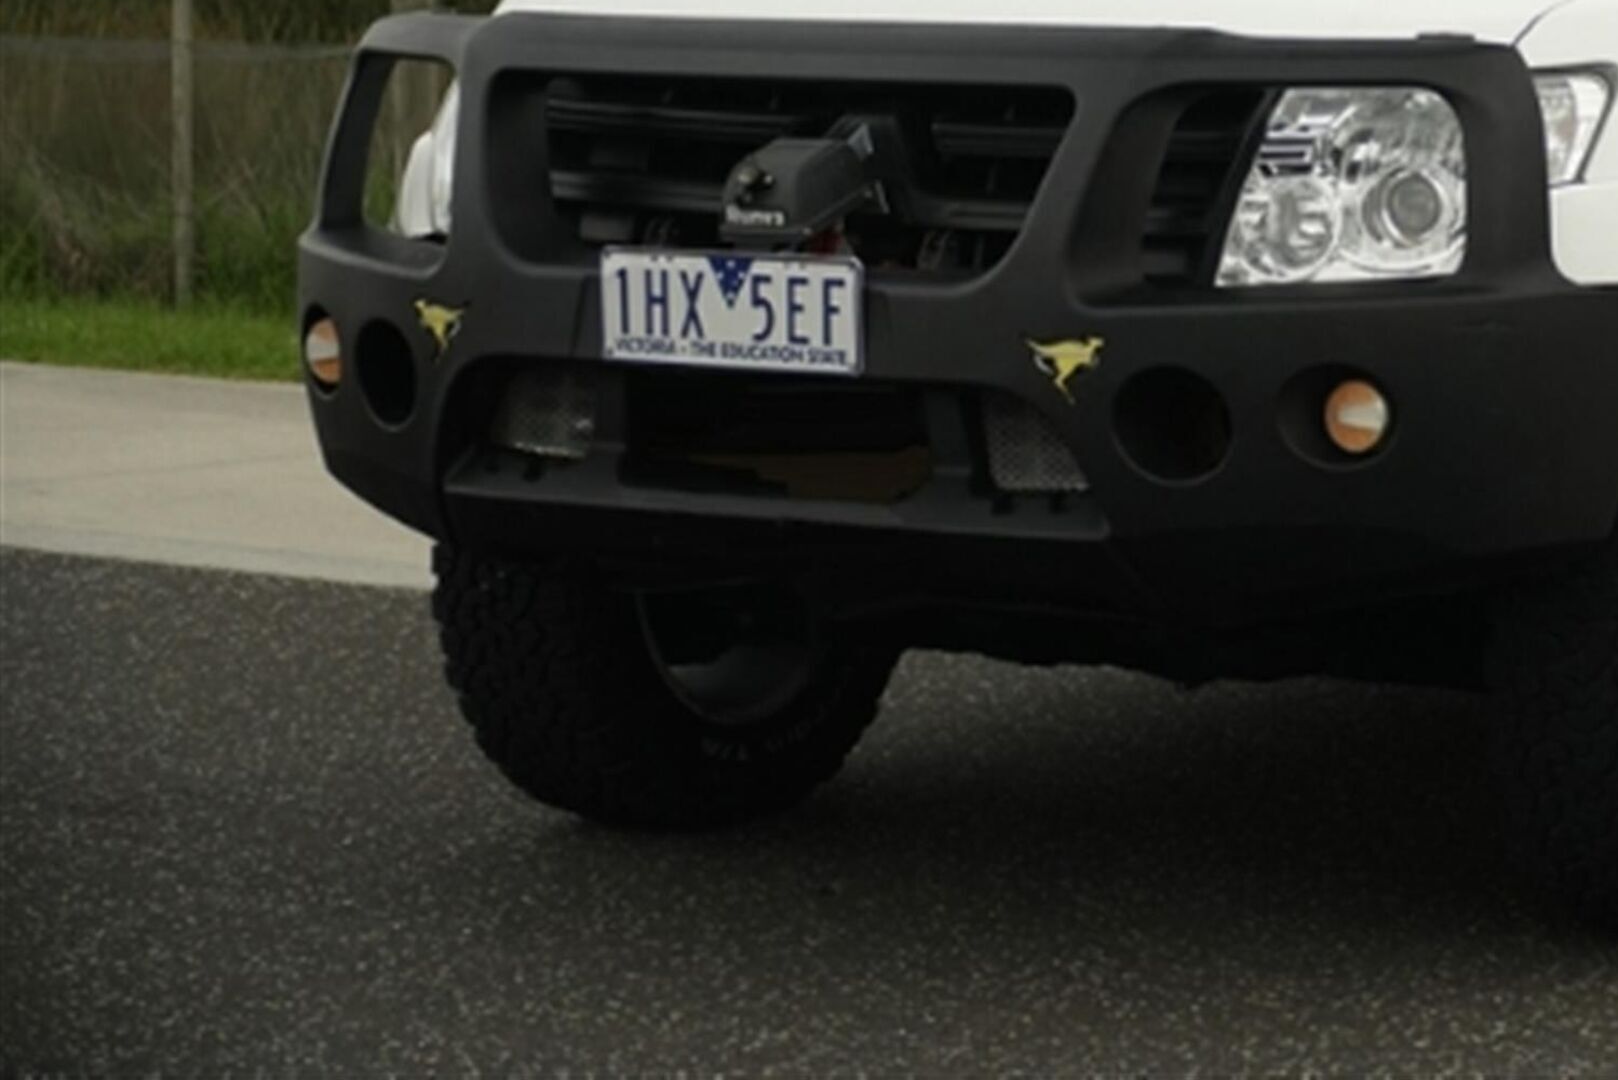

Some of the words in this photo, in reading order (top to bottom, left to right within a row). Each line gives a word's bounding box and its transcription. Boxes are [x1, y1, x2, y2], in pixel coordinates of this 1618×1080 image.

[616, 267, 705, 338] 1HX
[750, 274, 846, 346] 5EF
[615, 337, 676, 354] VICTORIA
[690, 341, 717, 357] THE
[720, 344, 804, 362] EDUCATION
[808, 349, 848, 366] STATE
